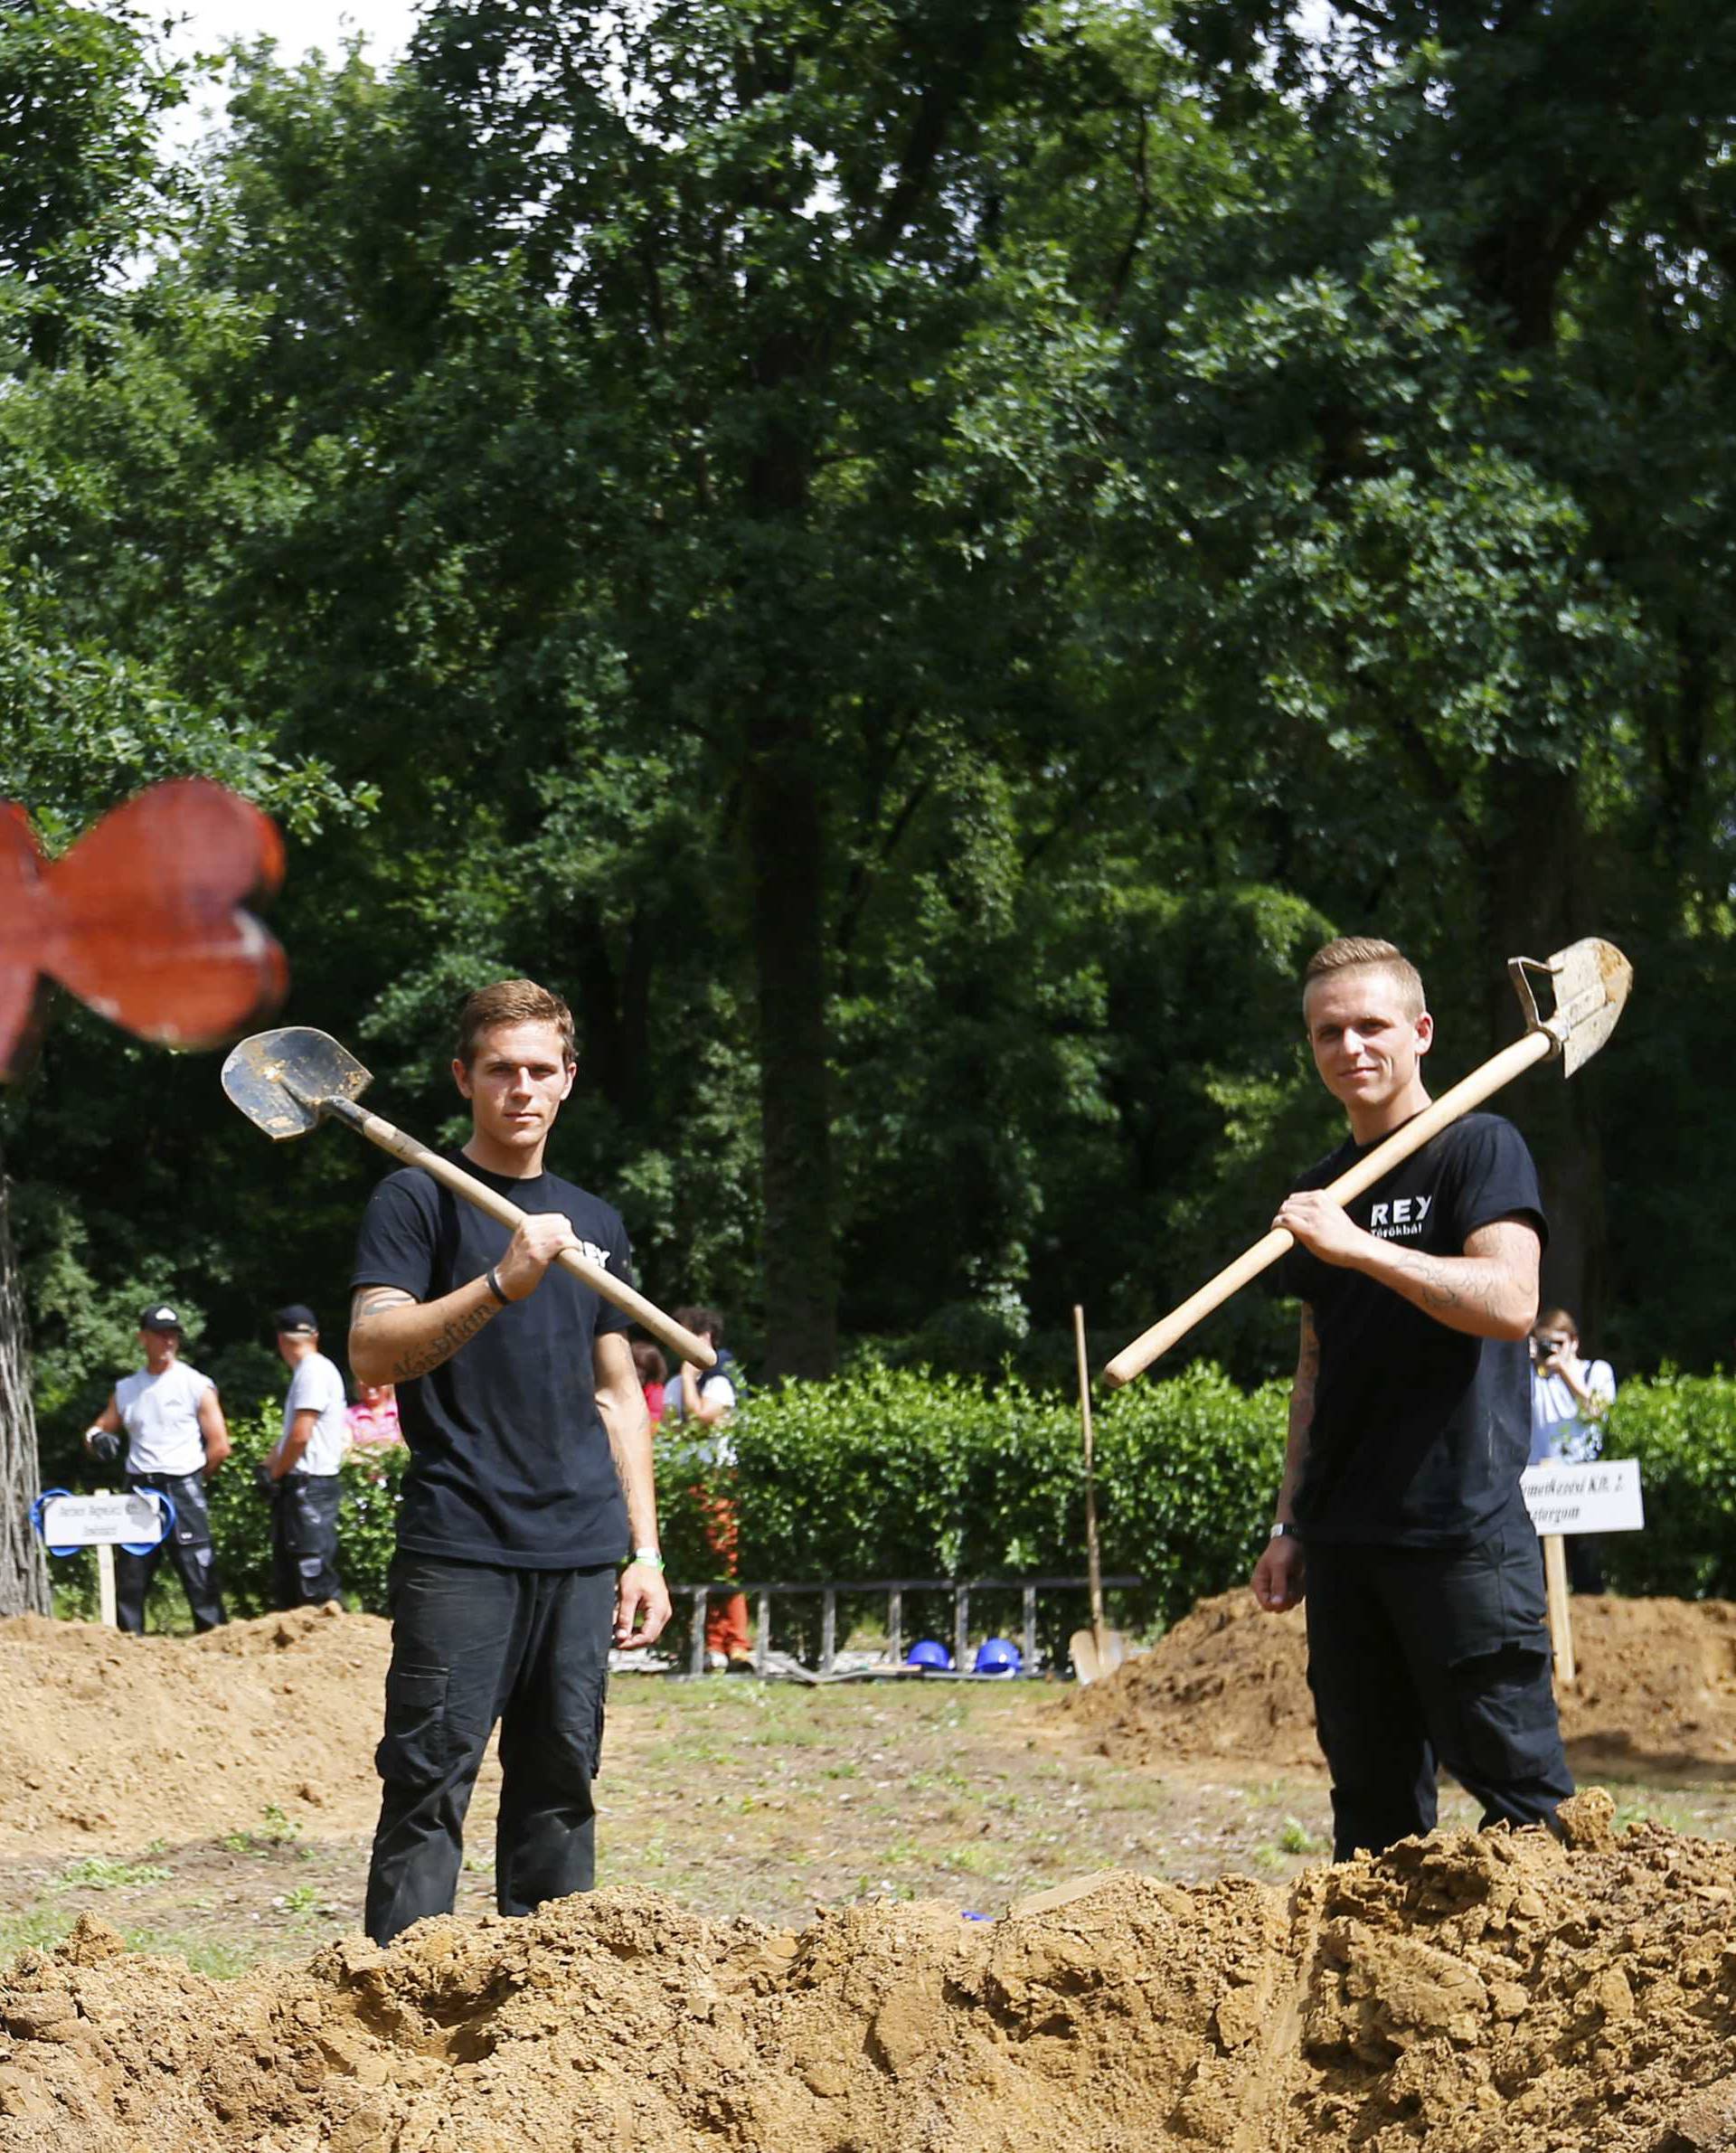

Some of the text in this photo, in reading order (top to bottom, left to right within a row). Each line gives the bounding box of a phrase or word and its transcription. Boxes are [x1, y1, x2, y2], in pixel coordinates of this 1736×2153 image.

[1371, 1195, 1431, 1227] REY
[1372, 1223, 1422, 1238] Törökbál
[583, 1242, 611, 1269] EY
